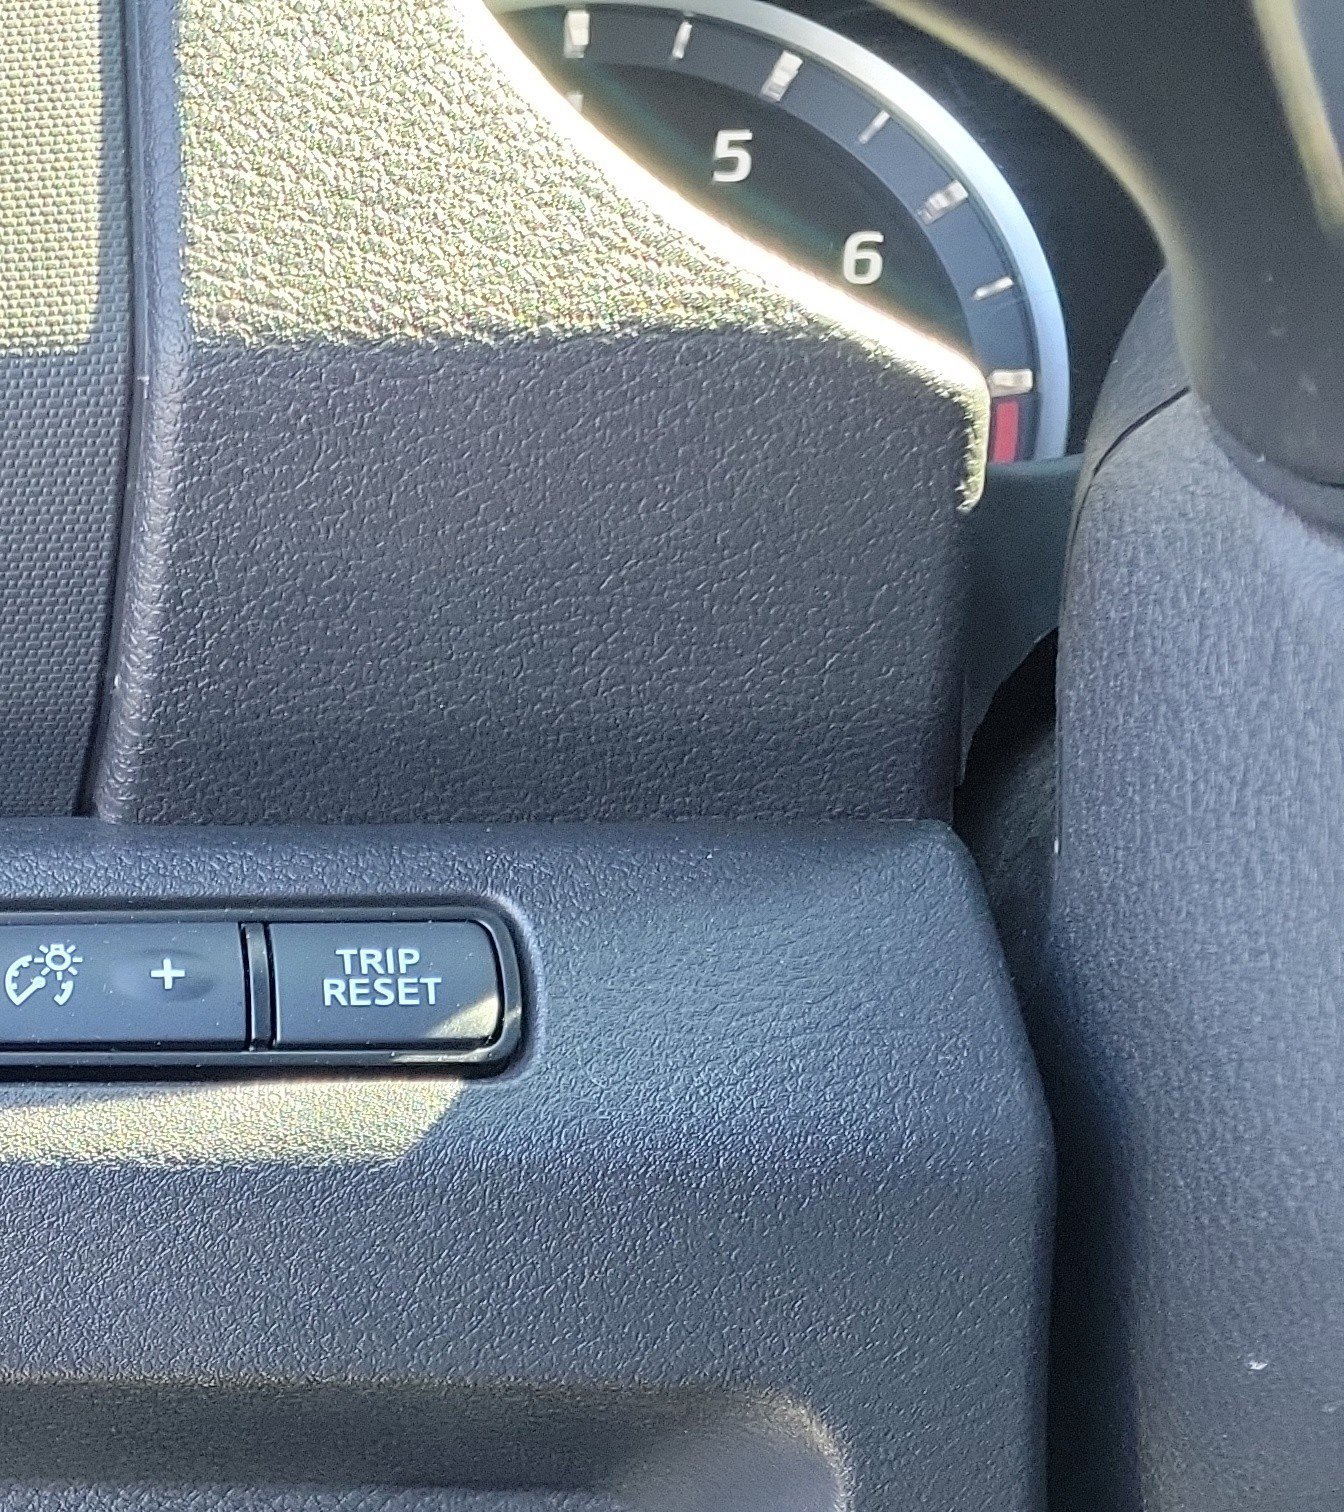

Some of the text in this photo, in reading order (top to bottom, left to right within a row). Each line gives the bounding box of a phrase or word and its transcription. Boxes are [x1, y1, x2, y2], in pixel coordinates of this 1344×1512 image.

[712, 129, 753, 183] 5
[842, 230, 884, 285] 6
[334, 946, 420, 975] TRIP
[322, 976, 442, 1006] RESET
